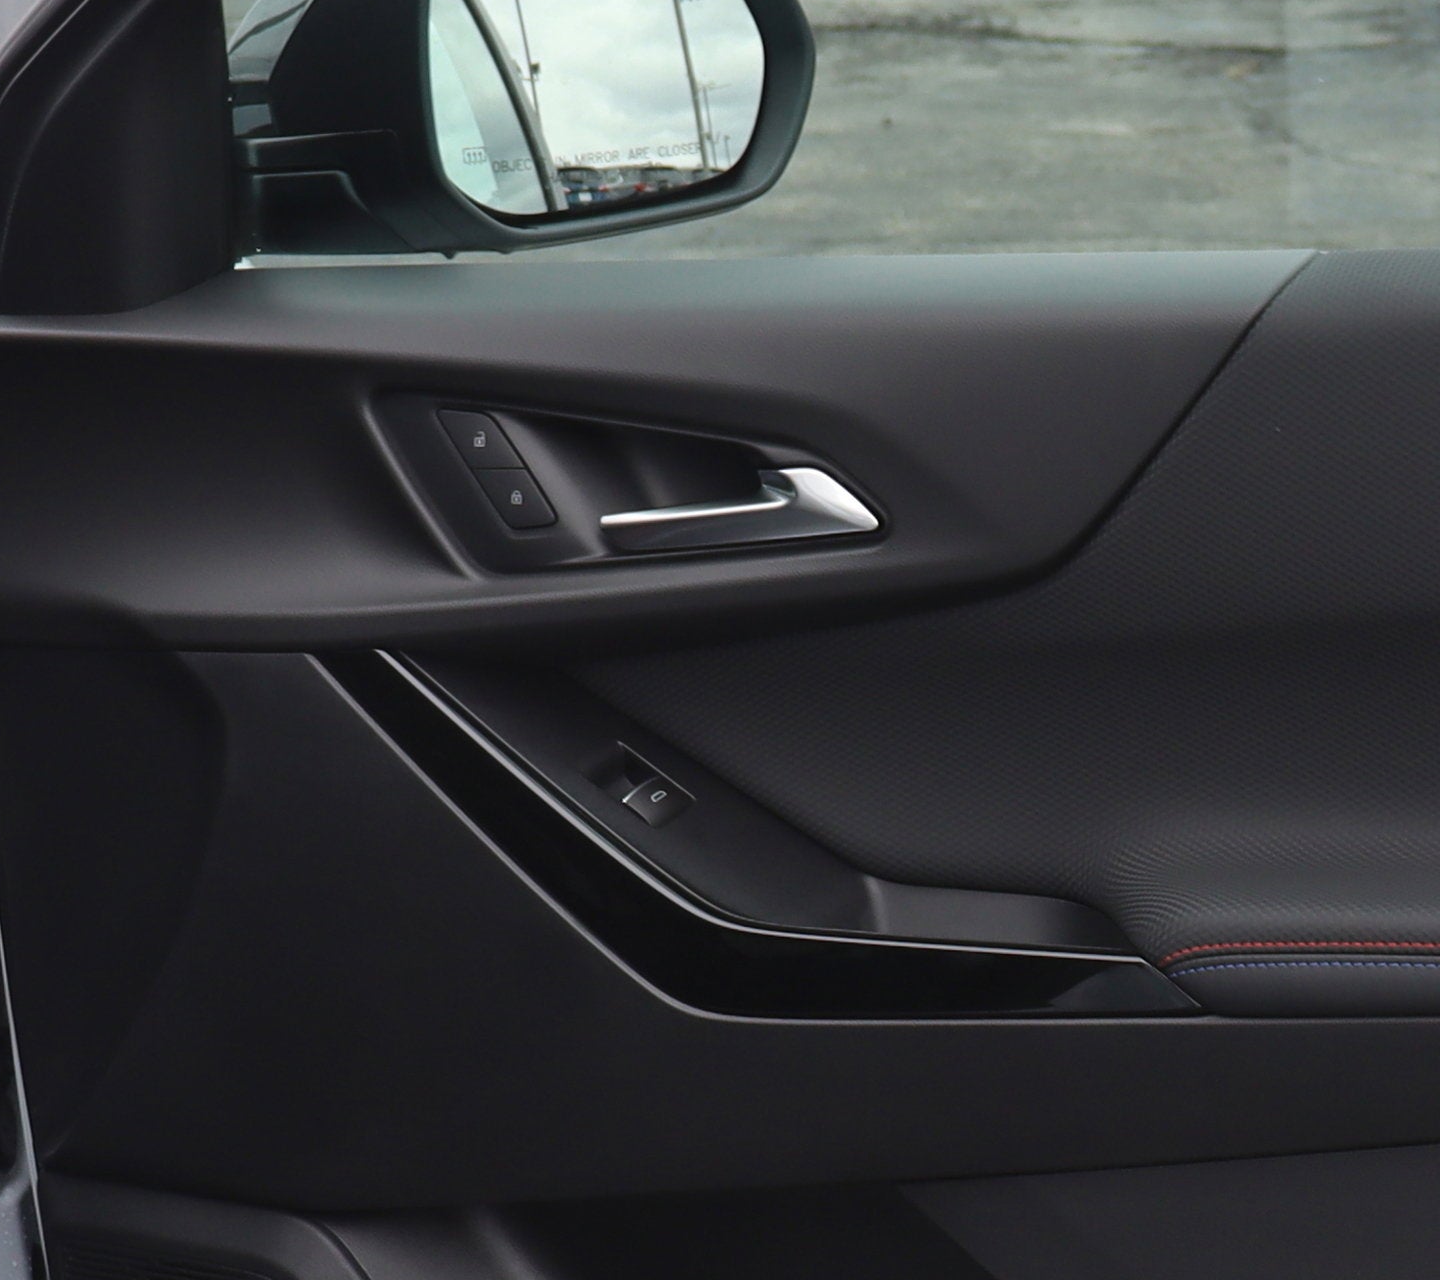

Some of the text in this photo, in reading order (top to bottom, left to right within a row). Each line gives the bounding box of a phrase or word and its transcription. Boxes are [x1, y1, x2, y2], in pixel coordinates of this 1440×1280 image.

[492, 157, 540, 173] OBJEC
[575, 150, 619, 167] MIRROR
[627, 146, 651, 161] ARE
